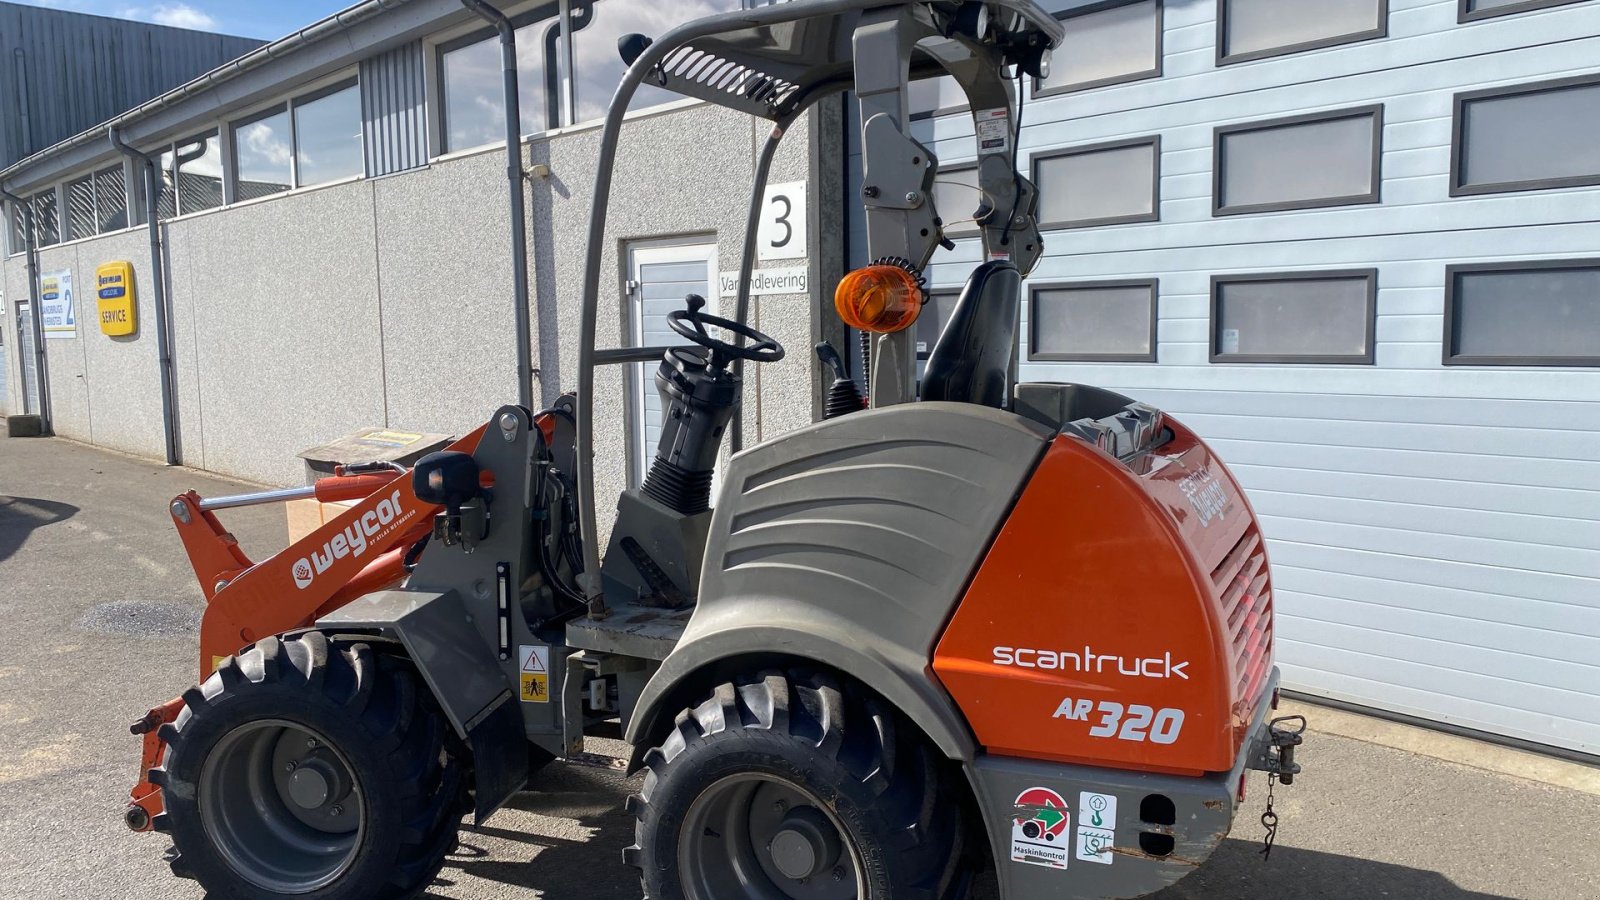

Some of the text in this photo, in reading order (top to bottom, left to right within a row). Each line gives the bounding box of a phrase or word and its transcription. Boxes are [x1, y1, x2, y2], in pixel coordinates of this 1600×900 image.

[771, 194, 792, 248] 3
[65, 289, 73, 324] 2
[102, 310, 126, 323] SERVICE
[311, 490, 402, 575] weycor
[376, 528, 391, 541] ATLAS
[992, 645, 1190, 680] scantruck
[1052, 697, 1185, 744] AR 320
[1013, 846, 1066, 861] Maskinkontrol
